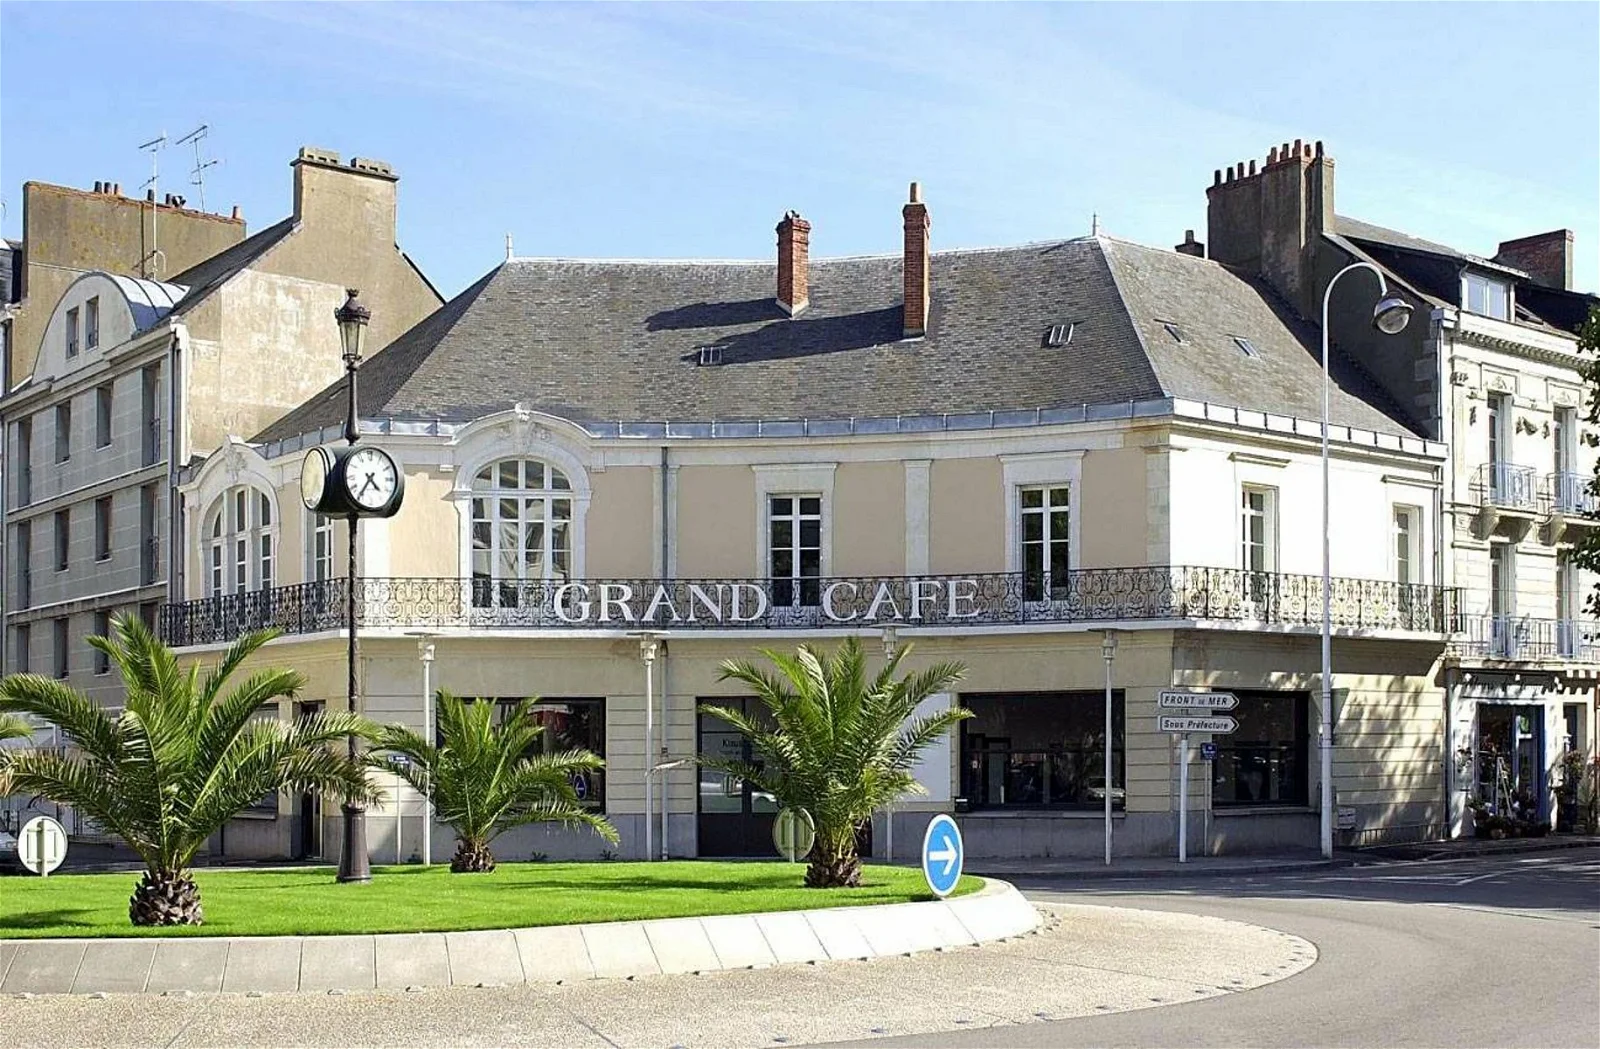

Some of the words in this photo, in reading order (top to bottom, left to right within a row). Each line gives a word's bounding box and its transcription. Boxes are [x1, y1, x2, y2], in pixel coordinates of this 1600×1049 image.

[553, 583, 768, 623] GRAND
[821, 579, 982, 622] CAFE
[1164, 695, 1194, 705] FRONT
[1208, 697, 1228, 706] MER
[1164, 719, 1184, 729] Sous
